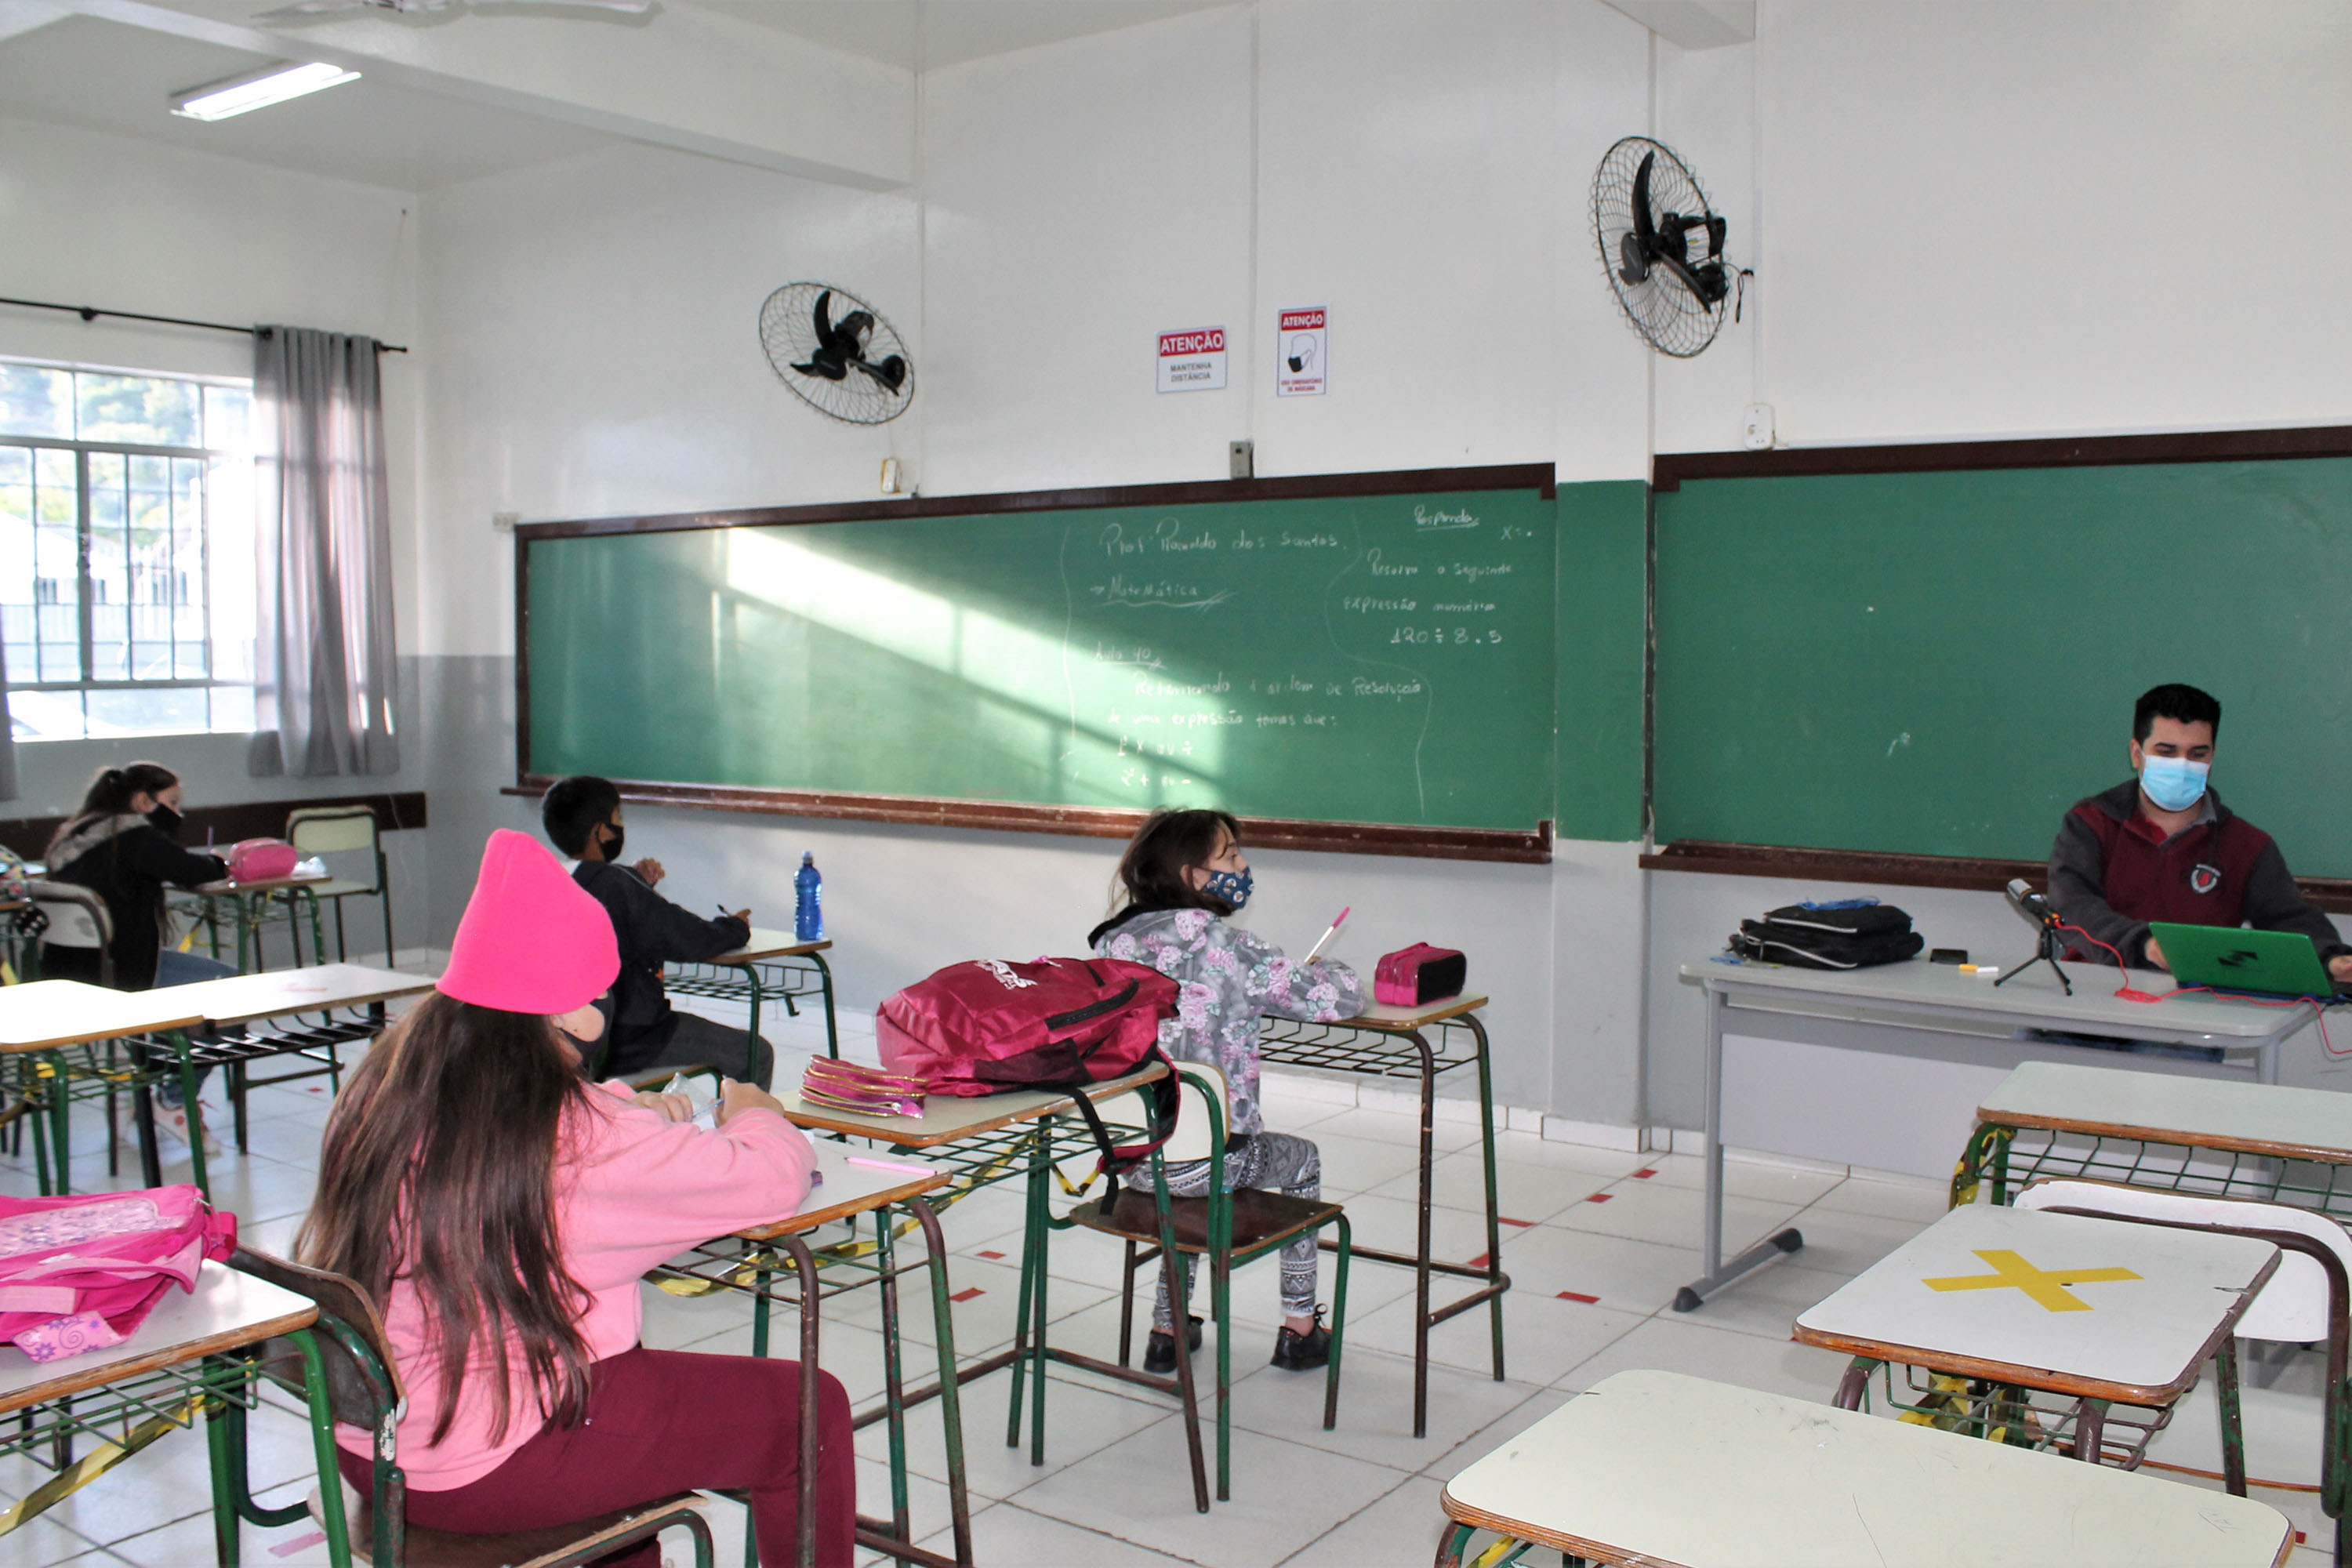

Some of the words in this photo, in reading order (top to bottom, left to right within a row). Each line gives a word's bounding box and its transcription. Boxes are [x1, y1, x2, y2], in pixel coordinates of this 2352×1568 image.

[1282, 314, 1323, 328] ATENÇÃO
[1160, 331, 1224, 354] ATENÇÃO
[1171, 362, 1212, 372] MANTENHA
[1171, 372, 1211, 383] DISTÂNCIA
[1232, 529, 1265, 549] dos
